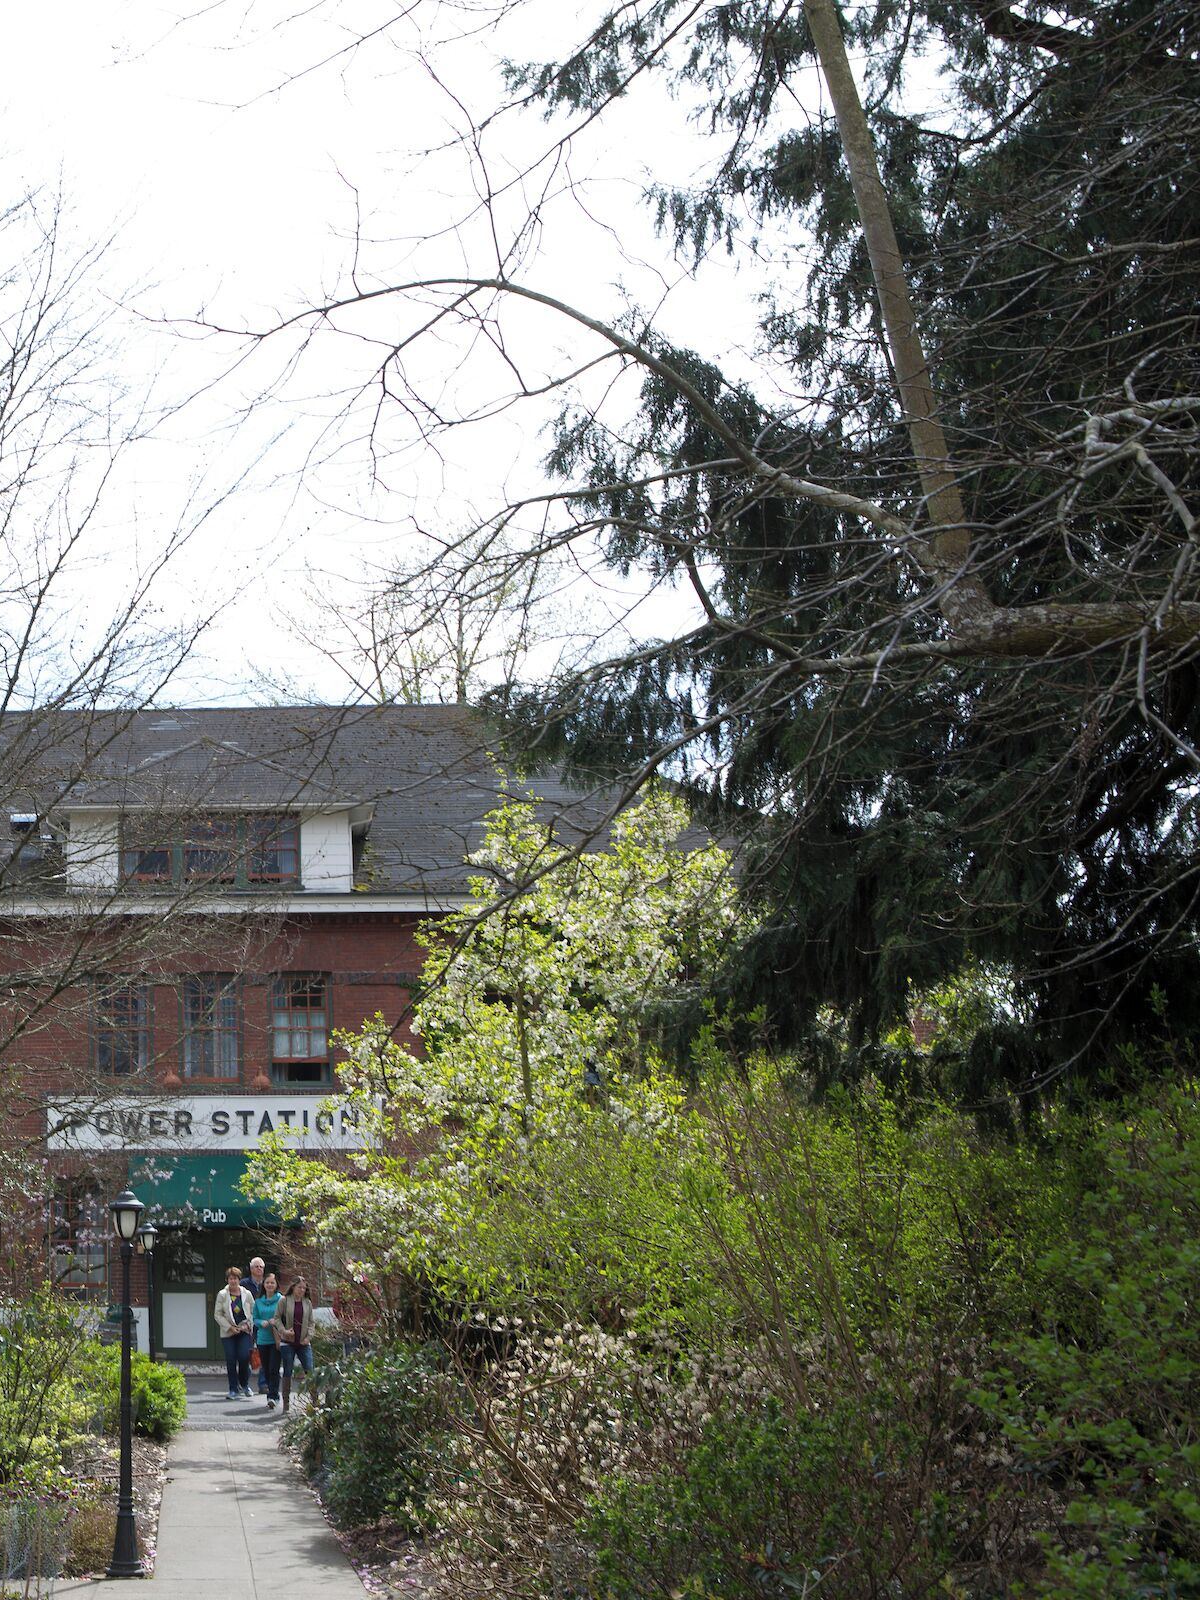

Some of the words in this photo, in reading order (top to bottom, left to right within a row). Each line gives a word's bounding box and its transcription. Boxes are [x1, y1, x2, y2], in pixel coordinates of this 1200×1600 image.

[71, 1110, 193, 1136] POWER
[211, 1110, 360, 1136] STATION
[203, 1208, 227, 1223] Pub
